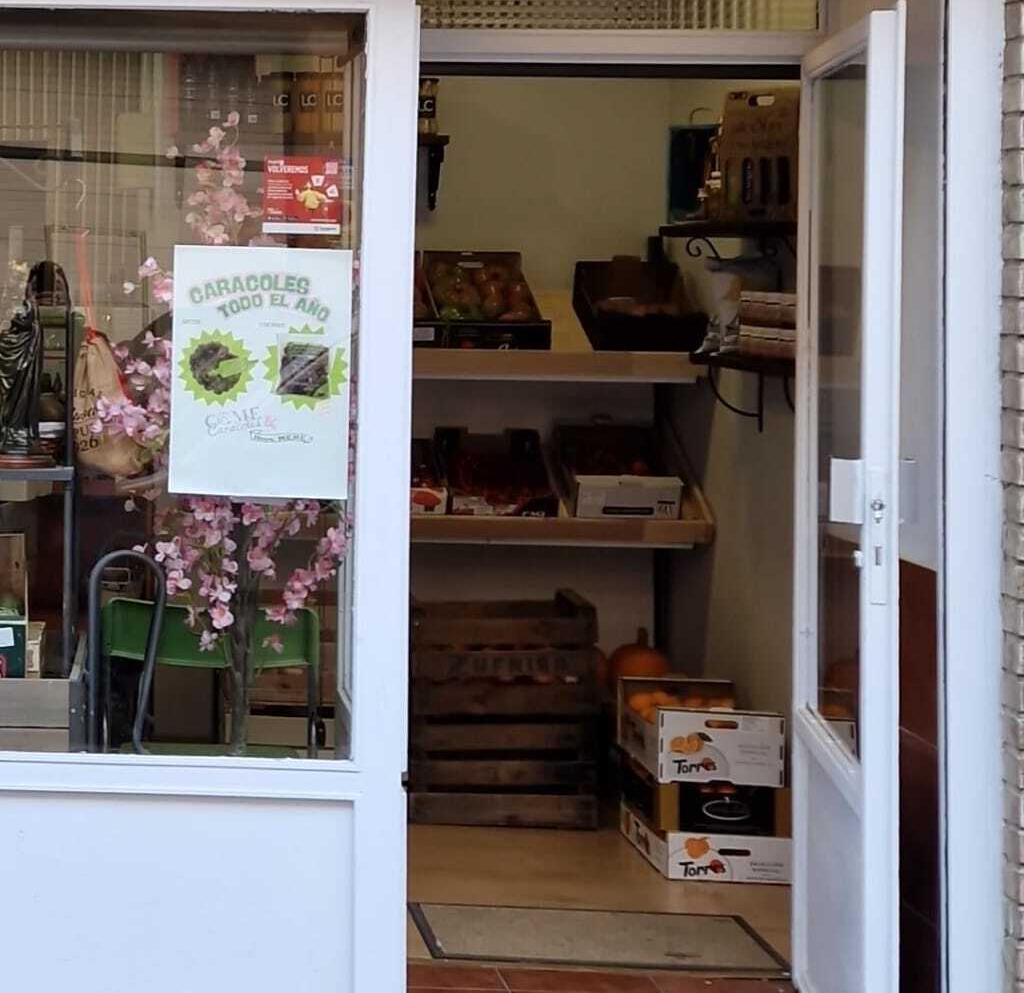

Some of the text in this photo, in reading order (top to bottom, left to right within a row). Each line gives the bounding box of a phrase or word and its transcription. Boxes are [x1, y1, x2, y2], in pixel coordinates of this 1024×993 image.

[189, 274, 311, 304] CARACOLES
[217, 293, 331, 322] TODO EL AÑO
